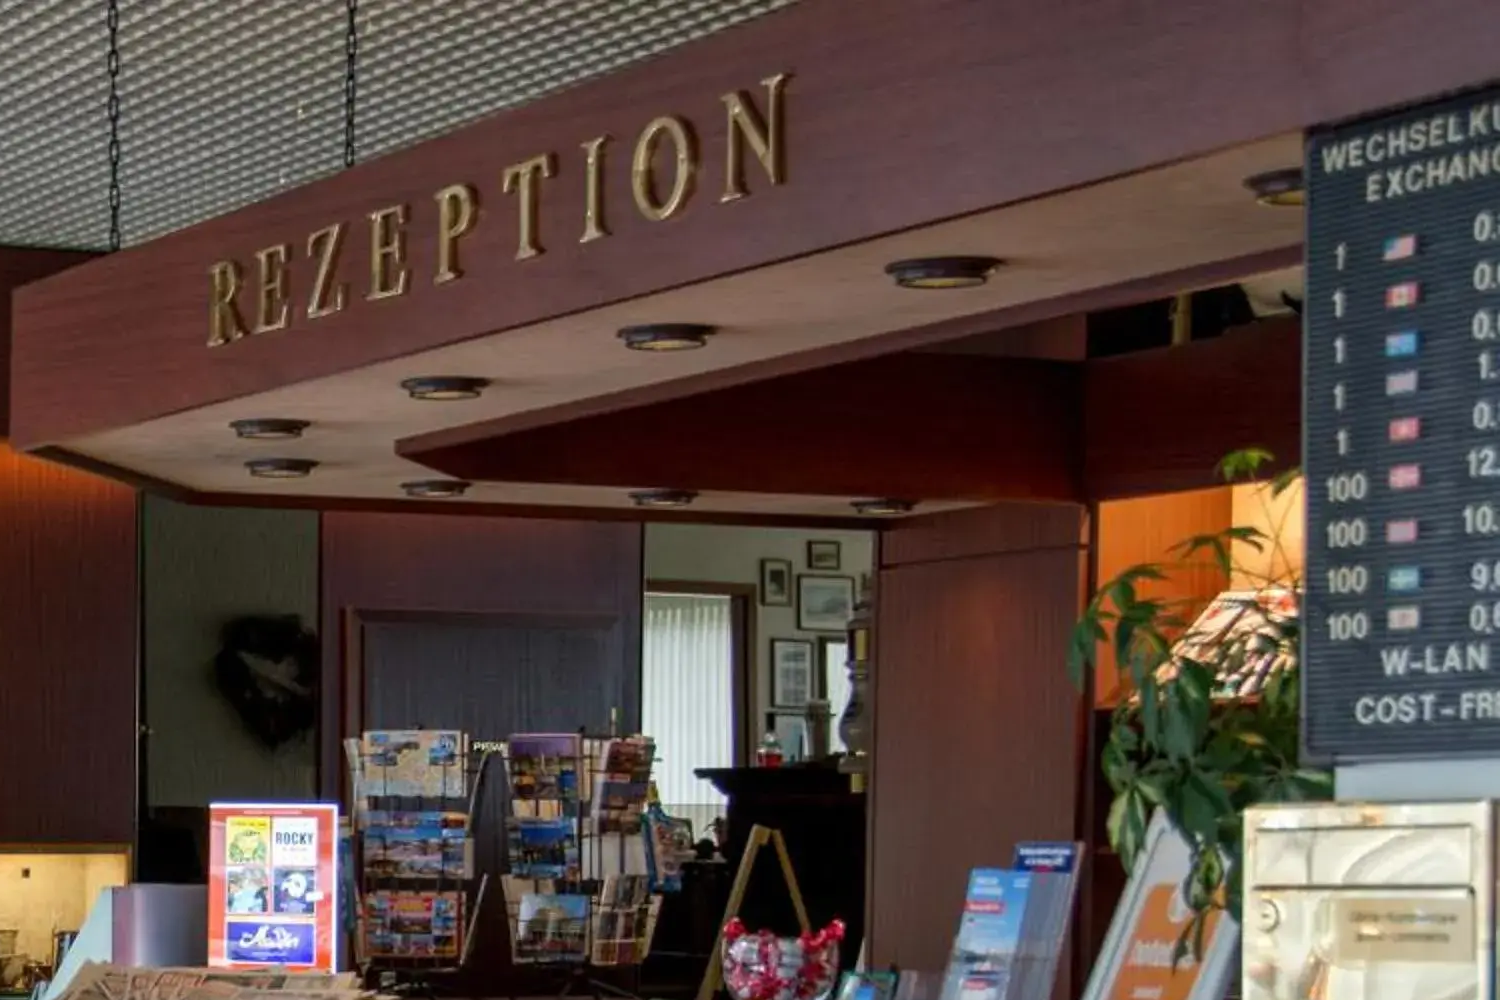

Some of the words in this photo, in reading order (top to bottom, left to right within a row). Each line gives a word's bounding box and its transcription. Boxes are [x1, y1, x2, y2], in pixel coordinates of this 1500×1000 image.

[206, 71, 792, 347] REZEPTION
[1334, 242, 1346, 271] 1
[1474, 211, 1500, 242] 0.
[1333, 289, 1345, 318] 1
[1474, 262, 1500, 291] 0.
[1333, 336, 1345, 364] 1
[1472, 310, 1500, 340] 0.
[1333, 383, 1345, 411] 1
[1336, 428, 1349, 456] 1
[1327, 473, 1368, 502] 100
[1327, 519, 1367, 548] 100
[1327, 565, 1368, 594] 100
[1327, 612, 1369, 641] 100
[1380, 643, 1489, 676] W-LAN
[275, 832, 314, 846] ROCKY
